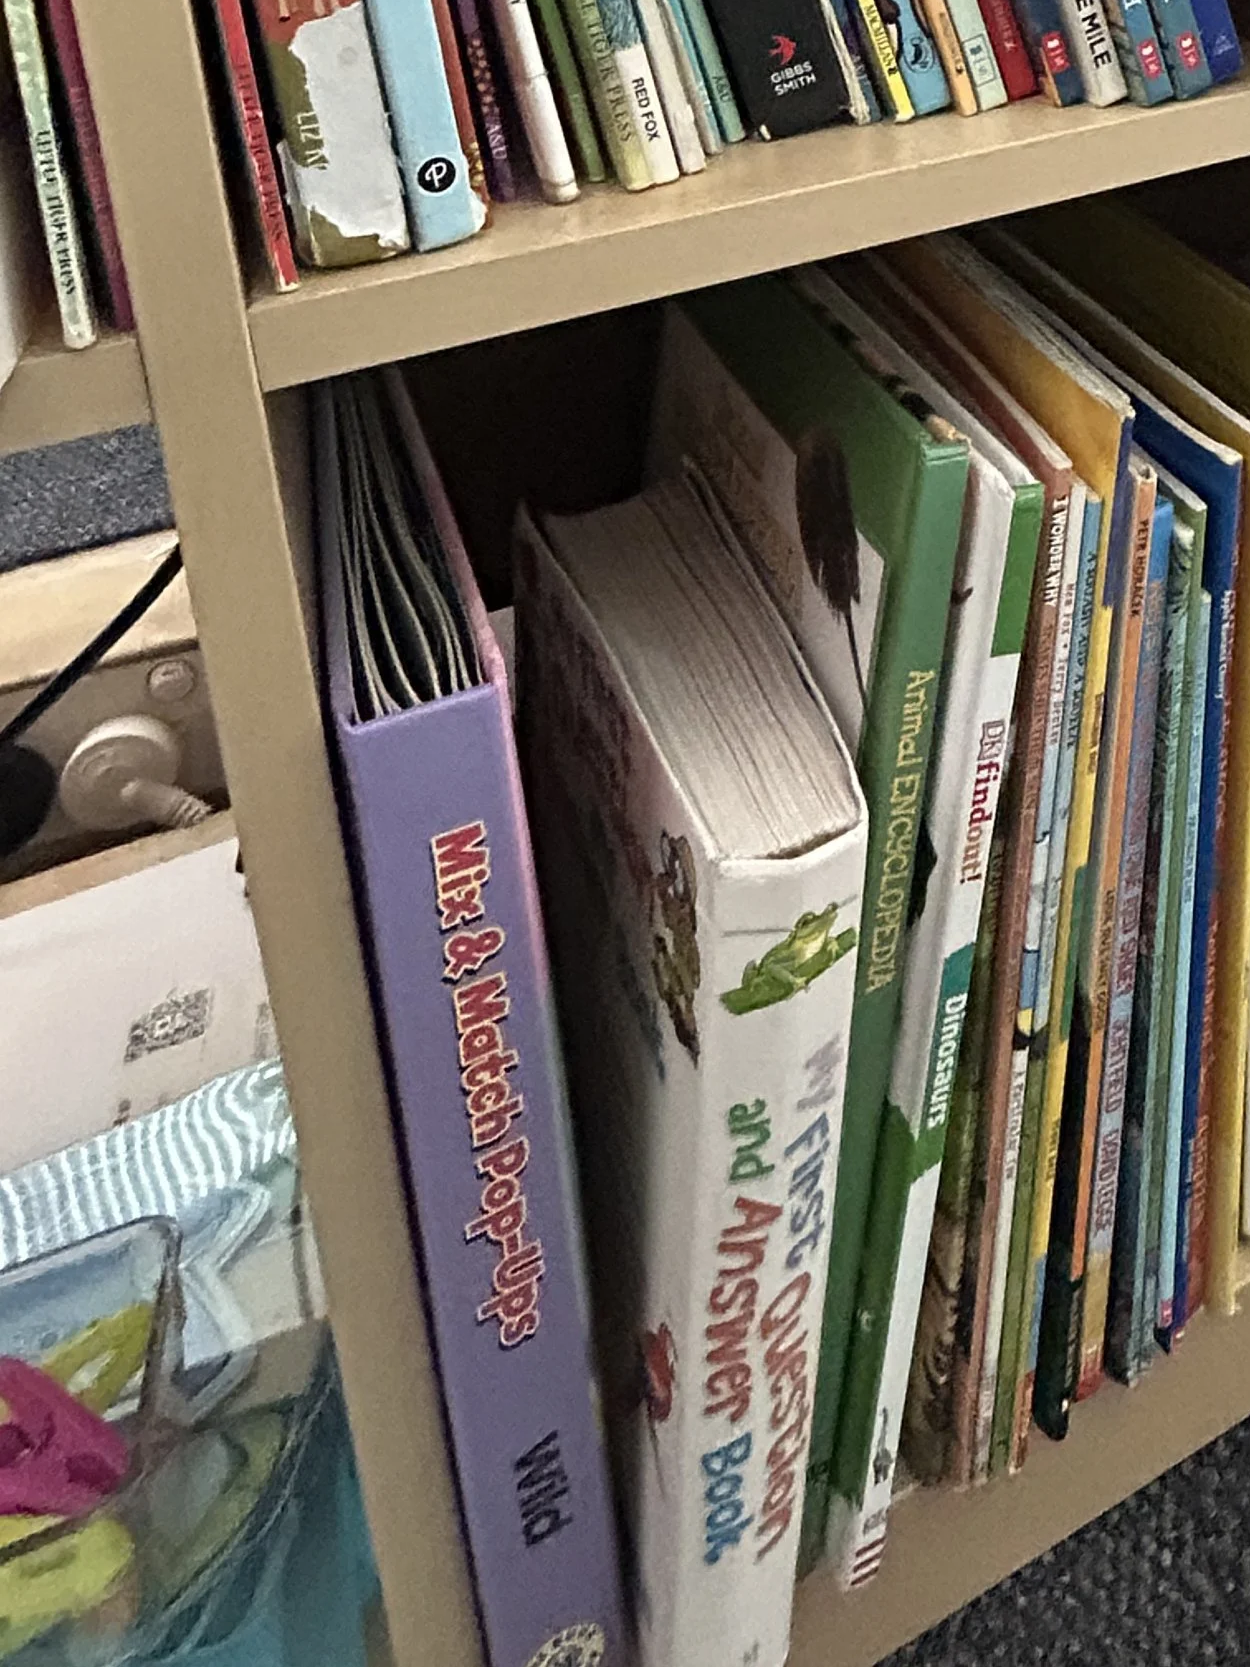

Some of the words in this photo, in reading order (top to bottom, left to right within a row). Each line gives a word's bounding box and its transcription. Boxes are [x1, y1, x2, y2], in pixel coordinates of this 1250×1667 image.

[1080, 12, 1113, 69] MILE
[630, 75, 652, 110] RED
[771, 60, 813, 83] GIBBS
[774, 74, 817, 96] SMITH
[639, 110, 662, 143] FOX
[45, 194, 69, 246] TIGER
[55, 246, 78, 296] PRESS
[1052, 495, 1068, 510] I
[1047, 508, 1067, 574] WONDER
[1042, 573, 1060, 608] WHY
[1063, 582, 1076, 607] Mem
[1060, 612, 1073, 635] Fox
[1049, 654, 1069, 695] Terry
[895, 669, 936, 769] Animal
[428, 820, 492, 932] Mix
[865, 772, 923, 993] ENCYCLOPEDIA
[441, 926, 506, 980] &
[446, 971, 528, 1150] Match
[926, 991, 969, 1130] Dinosaurs
[728, 1097, 777, 1184] and
[783, 1110, 829, 1272] First
[464, 1138, 545, 1351] Pop-Ups
[702, 1195, 784, 1423] Answer
[759, 1269, 813, 1563] Question
[513, 1430, 573, 1548] Wild
[700, 1431, 755, 1567] Book
